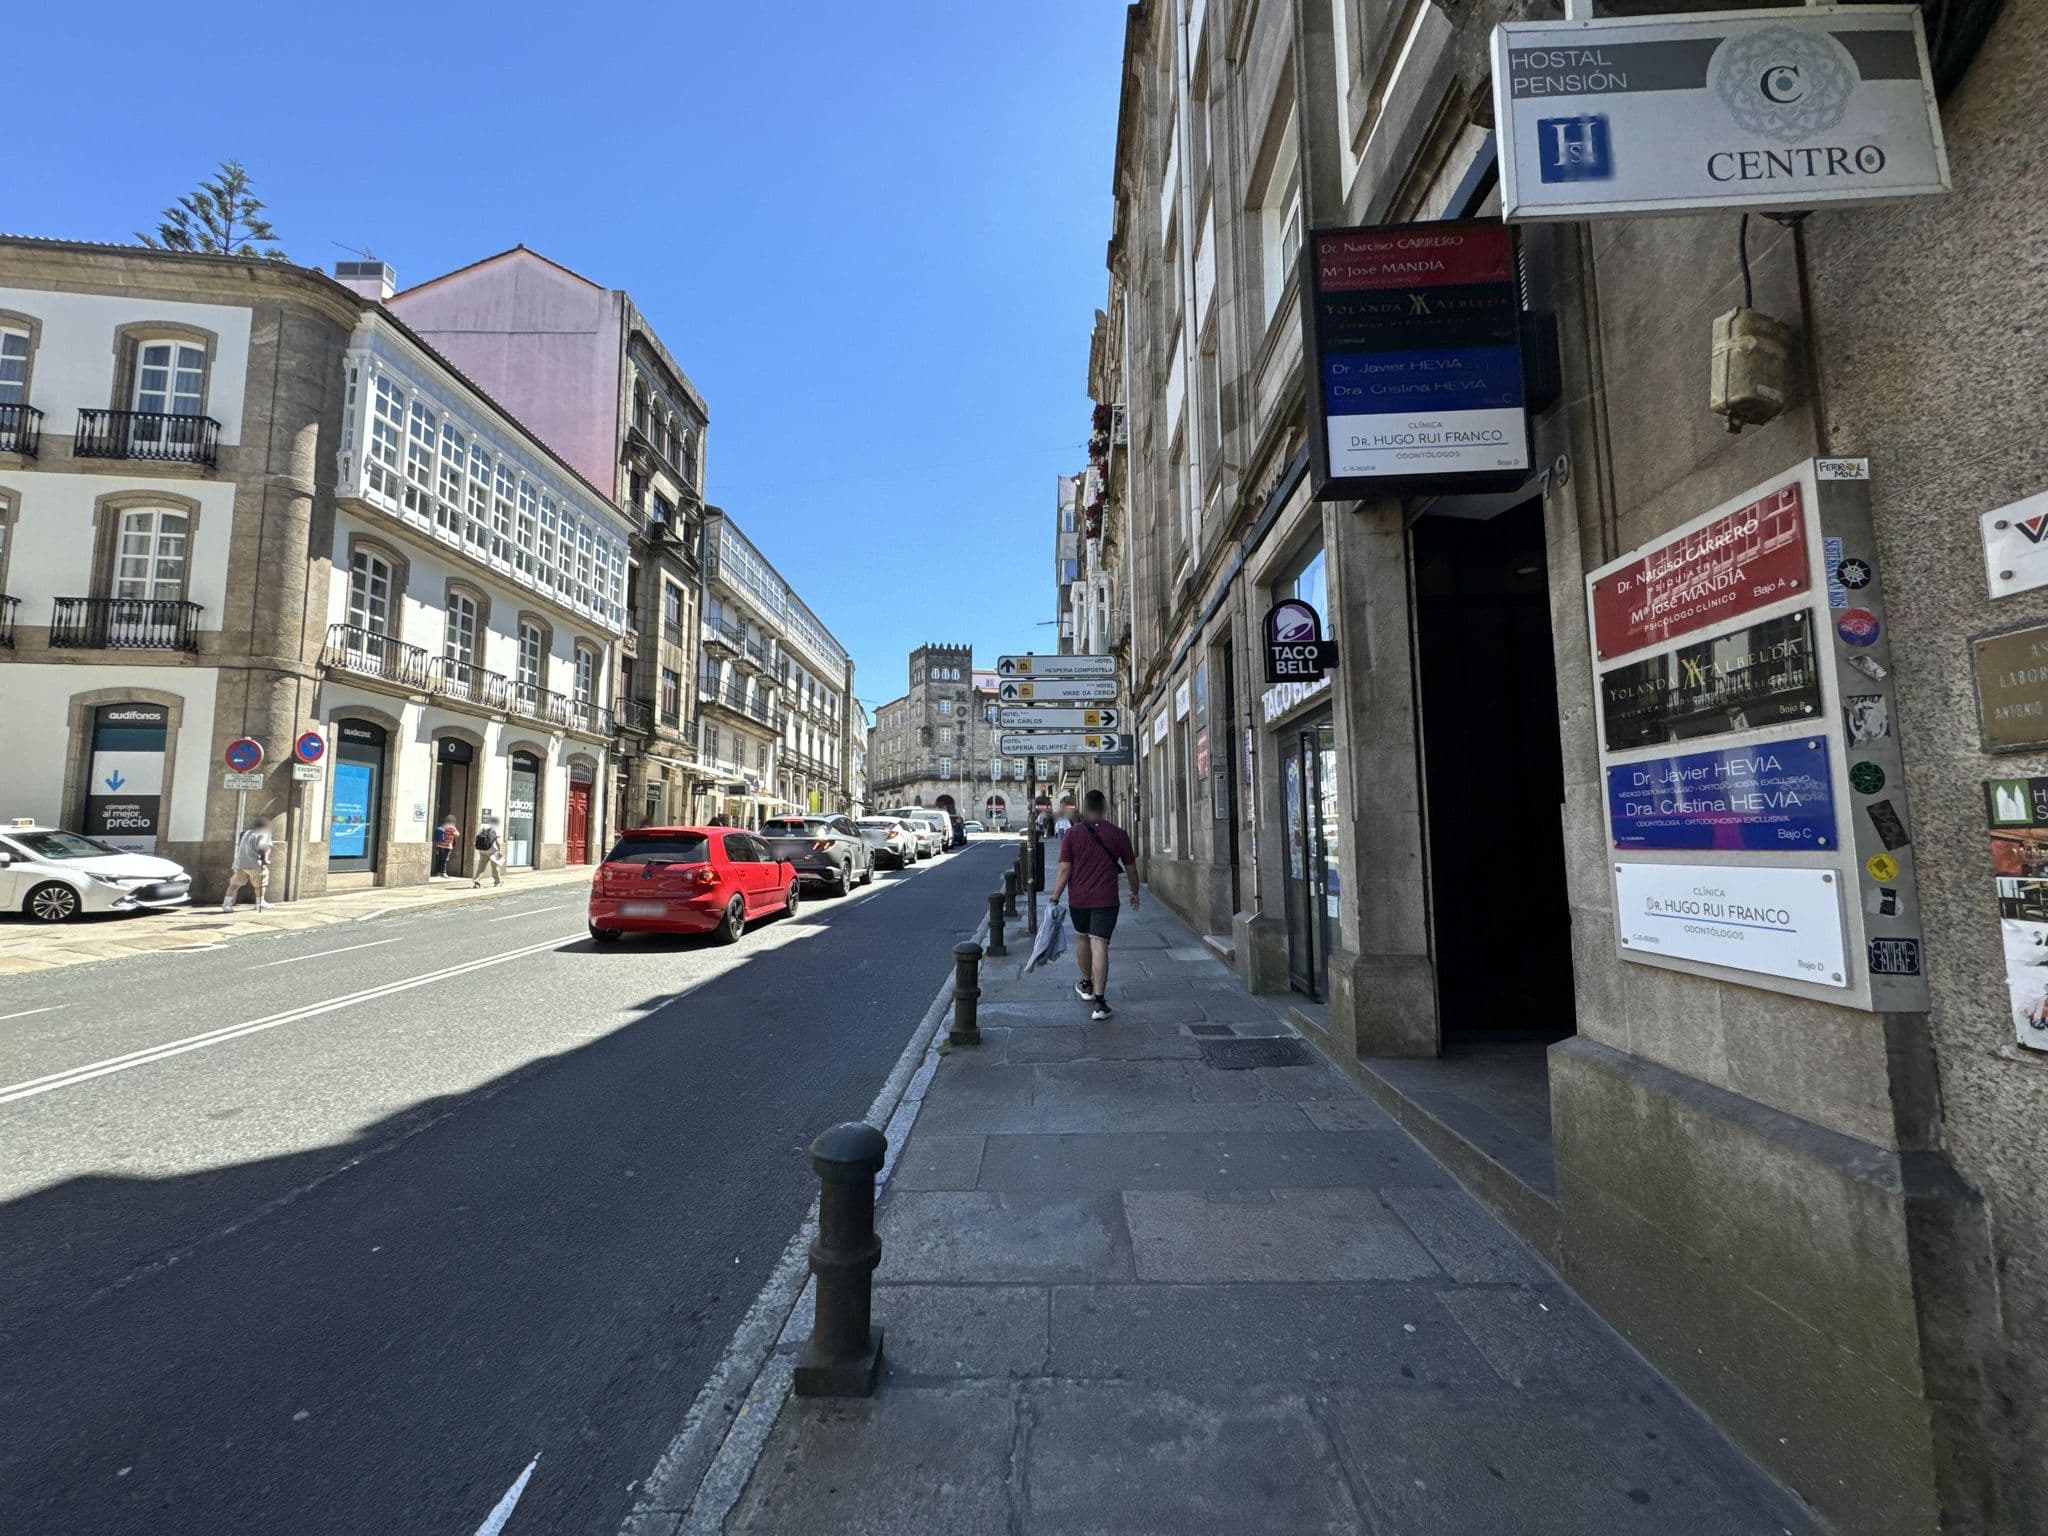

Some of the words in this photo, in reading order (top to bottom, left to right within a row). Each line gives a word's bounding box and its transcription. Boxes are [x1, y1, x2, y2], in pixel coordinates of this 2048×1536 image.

[1511, 50, 1612, 70] HOSTAL
[1513, 69, 1628, 94] PENSIÓN
[1707, 145, 1886, 182] CENTRO
[1410, 357, 1463, 371] HEVIA
[1374, 433, 1415, 446] HUGO
[1418, 432, 1442, 445] RUI
[1446, 429, 1504, 443] FRANCO
[1617, 580, 1633, 594] Dr.
[1636, 557, 1683, 586] Narciso
[1686, 518, 1759, 562] CARRERO
[1753, 583, 1776, 598] Bajo
[1778, 577, 1786, 588] A
[1271, 646, 1318, 659] TACO
[1711, 643, 1799, 676] ALBELDA
[1276, 660, 1319, 674] BELL
[1608, 678, 1677, 702] YOLANDA
[1779, 703, 1798, 715] Bajo
[1633, 771, 1655, 787] Dr.
[1659, 766, 1710, 785] Javier
[1714, 755, 1782, 777] HEVIA
[1760, 774, 1811, 787] EXCLUSIVO
[1625, 802, 1657, 817] Dra.
[1660, 799, 1727, 815] Cristina
[1731, 791, 1803, 811] HEVIA
[103, 810, 112, 818] al
[1743, 814, 1791, 824] EXCLUSIVA
[106, 816, 151, 831] precio
[1777, 829, 1800, 841] Bajo
[1802, 828, 1813, 839] C
[1693, 886, 1726, 899] CLÍNICA
[1664, 899, 1701, 916] HUGO
[1703, 902, 1725, 918] RUI
[1728, 904, 1791, 925] FRANCO
[1684, 924, 1745, 941] ODONTÓLOGOS
